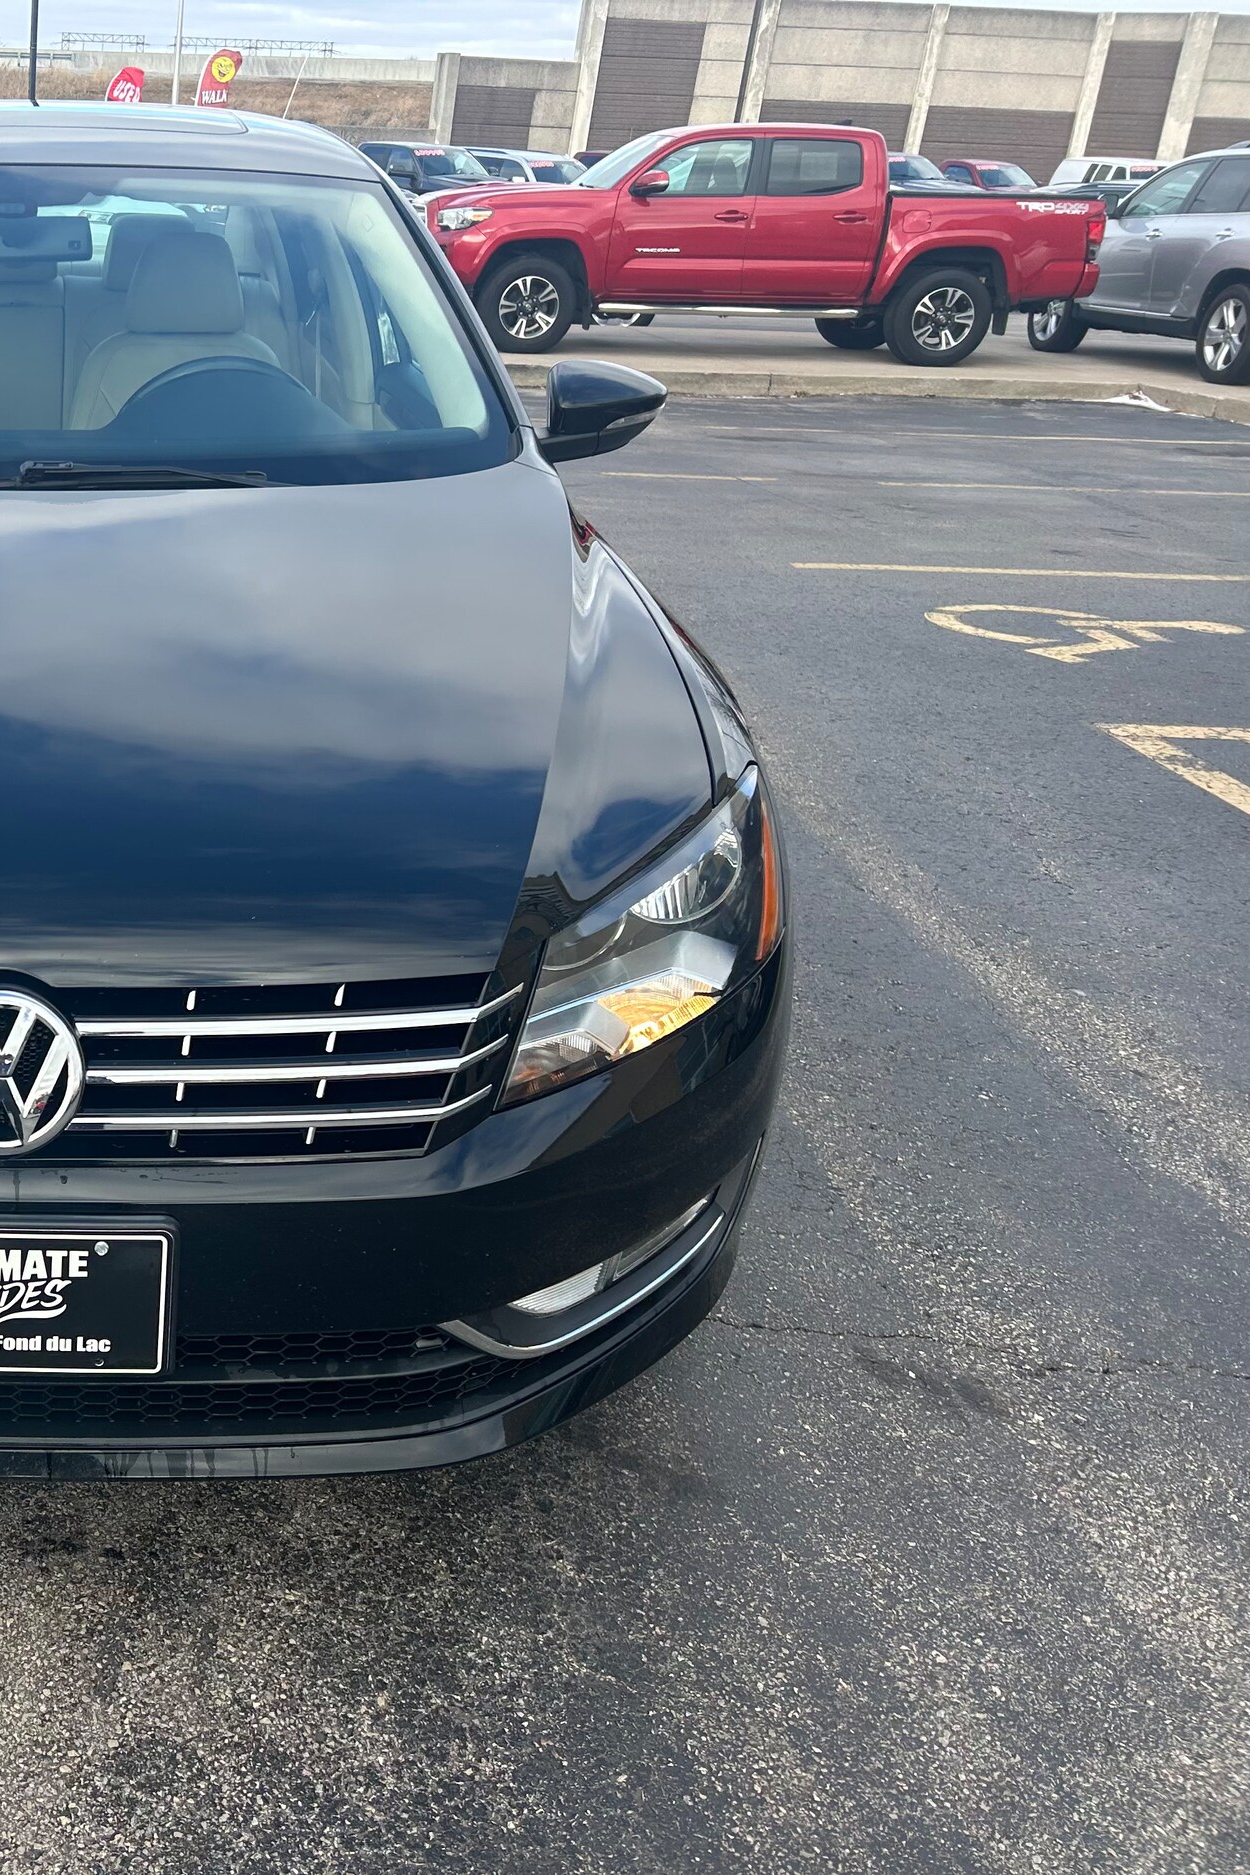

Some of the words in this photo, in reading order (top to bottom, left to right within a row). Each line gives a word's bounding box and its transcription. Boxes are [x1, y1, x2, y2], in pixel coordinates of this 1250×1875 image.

[1015, 201, 1055, 213] TRD
[45, 1335, 72, 1352] du
[76, 1336, 112, 1353] Lac
